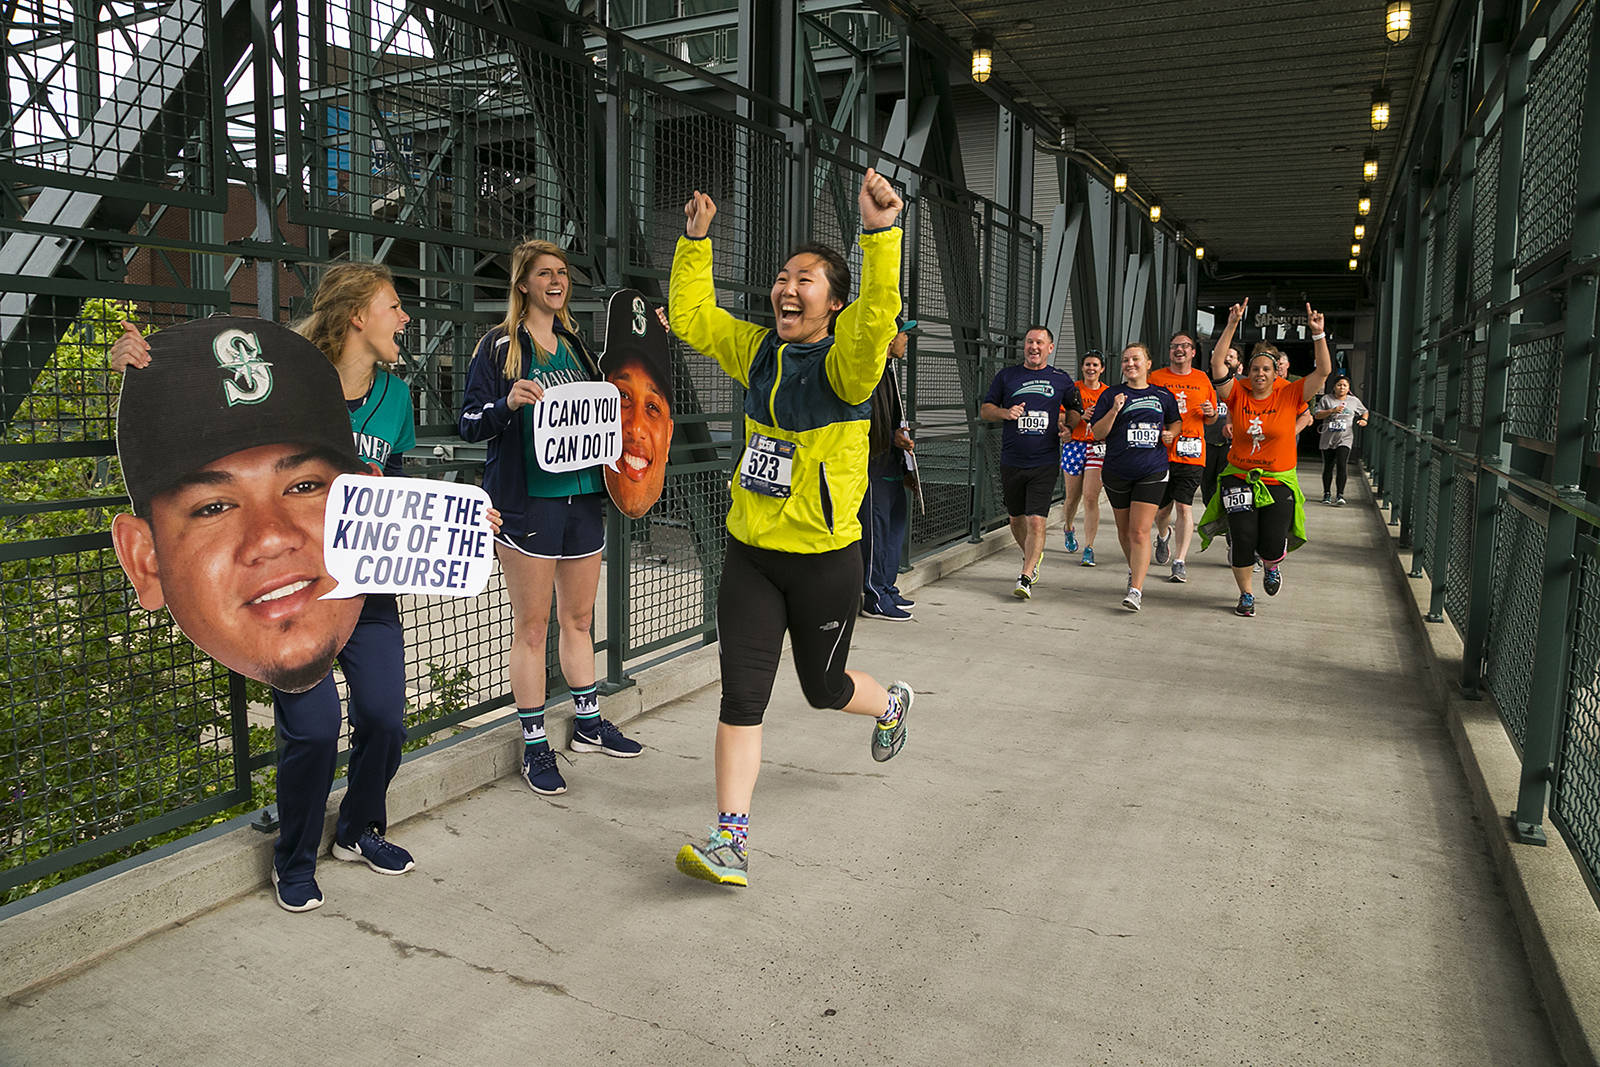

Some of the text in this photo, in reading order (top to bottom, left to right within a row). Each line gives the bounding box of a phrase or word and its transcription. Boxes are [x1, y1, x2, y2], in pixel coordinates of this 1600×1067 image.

[537, 397, 618, 429] I CANO YOU
[1021, 417, 1045, 428] 1094
[544, 431, 616, 465] CAN DO IT
[1131, 430, 1157, 441] 1093
[748, 450, 780, 482] 523
[342, 484, 485, 527] YOU'RE THE
[1227, 493, 1246, 507] 750
[332, 519, 488, 558] KING OF THE
[354, 555, 470, 589] COURSE!
